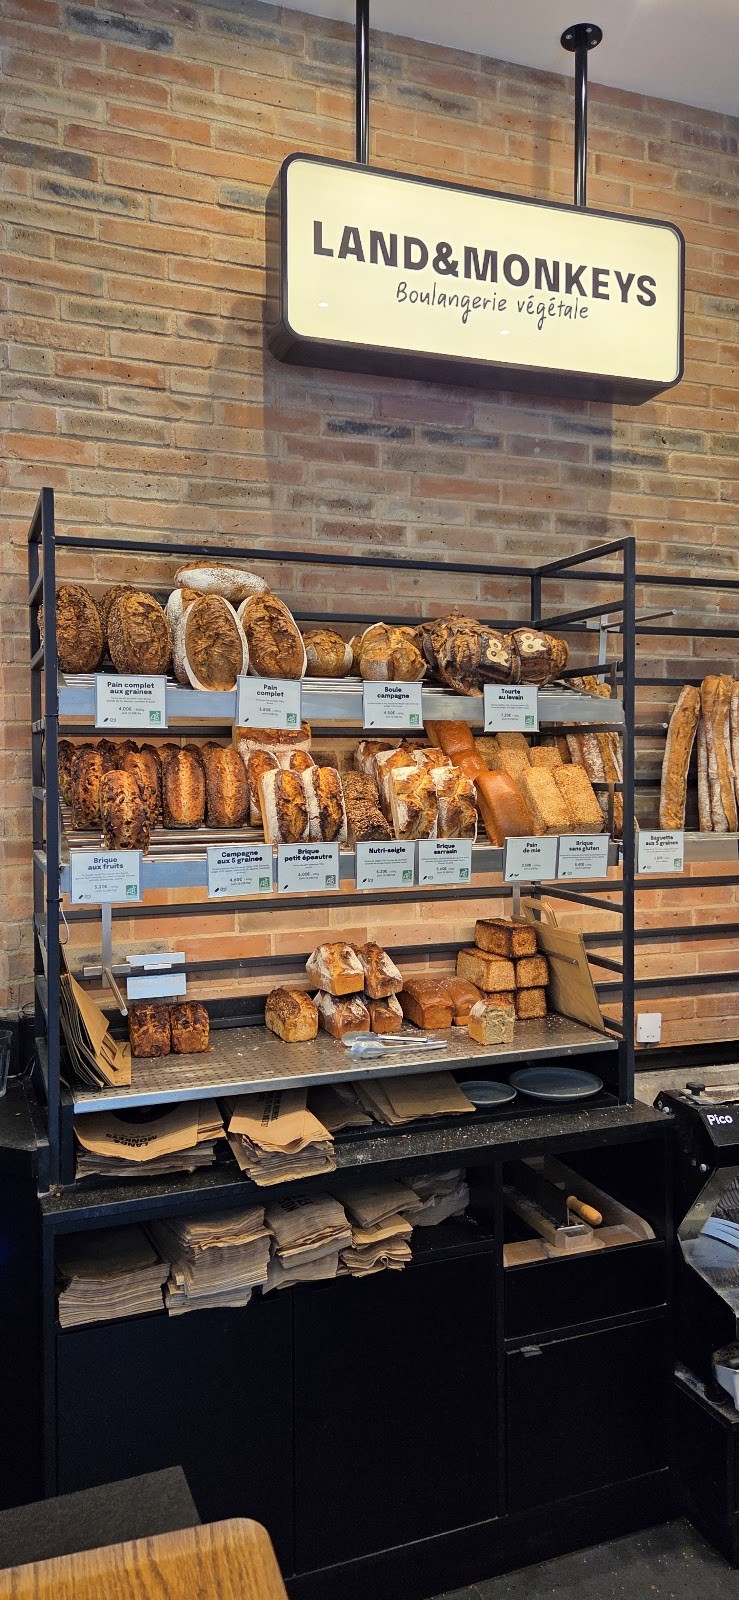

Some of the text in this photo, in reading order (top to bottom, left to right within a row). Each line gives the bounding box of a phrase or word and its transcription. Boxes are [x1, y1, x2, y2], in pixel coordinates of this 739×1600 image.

[313, 220, 657, 307] LAND&MONKEYS
[396, 281, 589, 331] Boulangerie végétale
[707, 1114, 733, 1126] Pico
